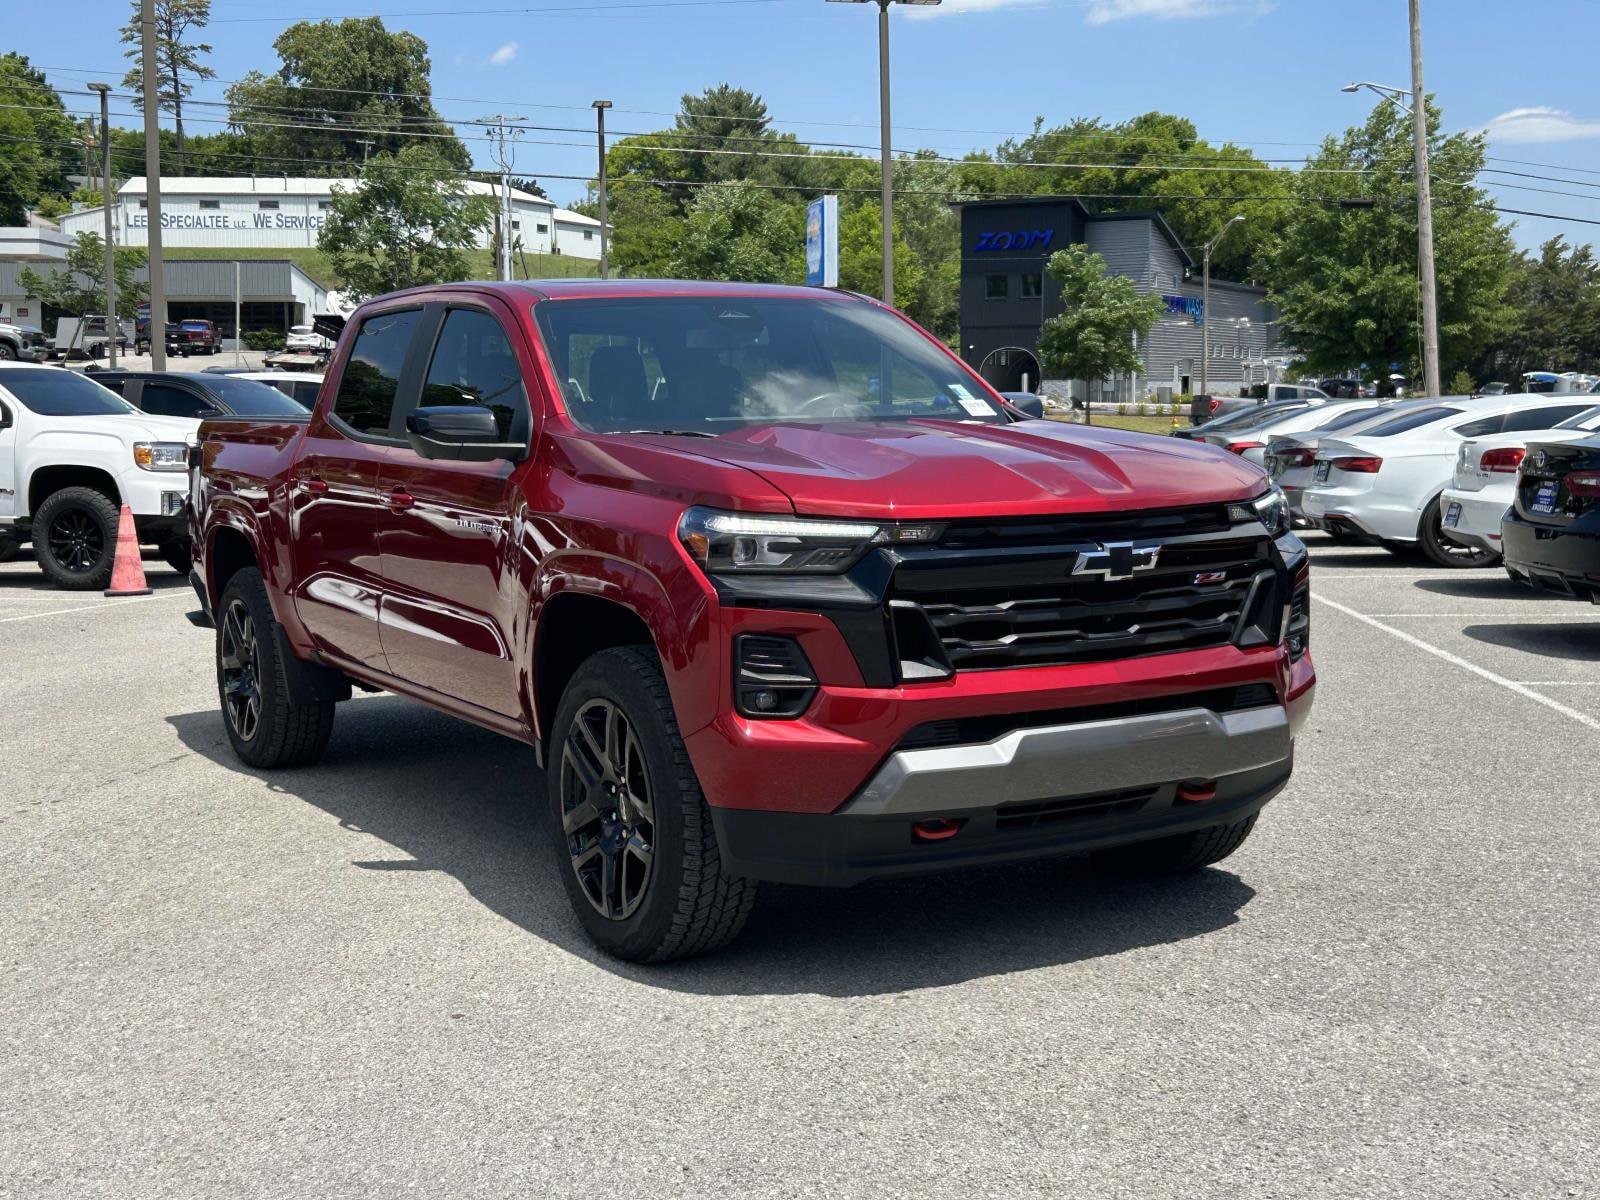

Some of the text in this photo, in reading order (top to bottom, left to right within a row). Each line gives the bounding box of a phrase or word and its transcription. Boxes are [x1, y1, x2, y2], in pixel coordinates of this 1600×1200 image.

[161, 212, 230, 229] SPECIALTEE
[233, 219, 247, 229] LLC
[253, 212, 272, 229] WE
[276, 212, 325, 230] SERVICE
[975, 228, 1054, 251] ZOOM
[1186, 297, 1204, 316] WASH
